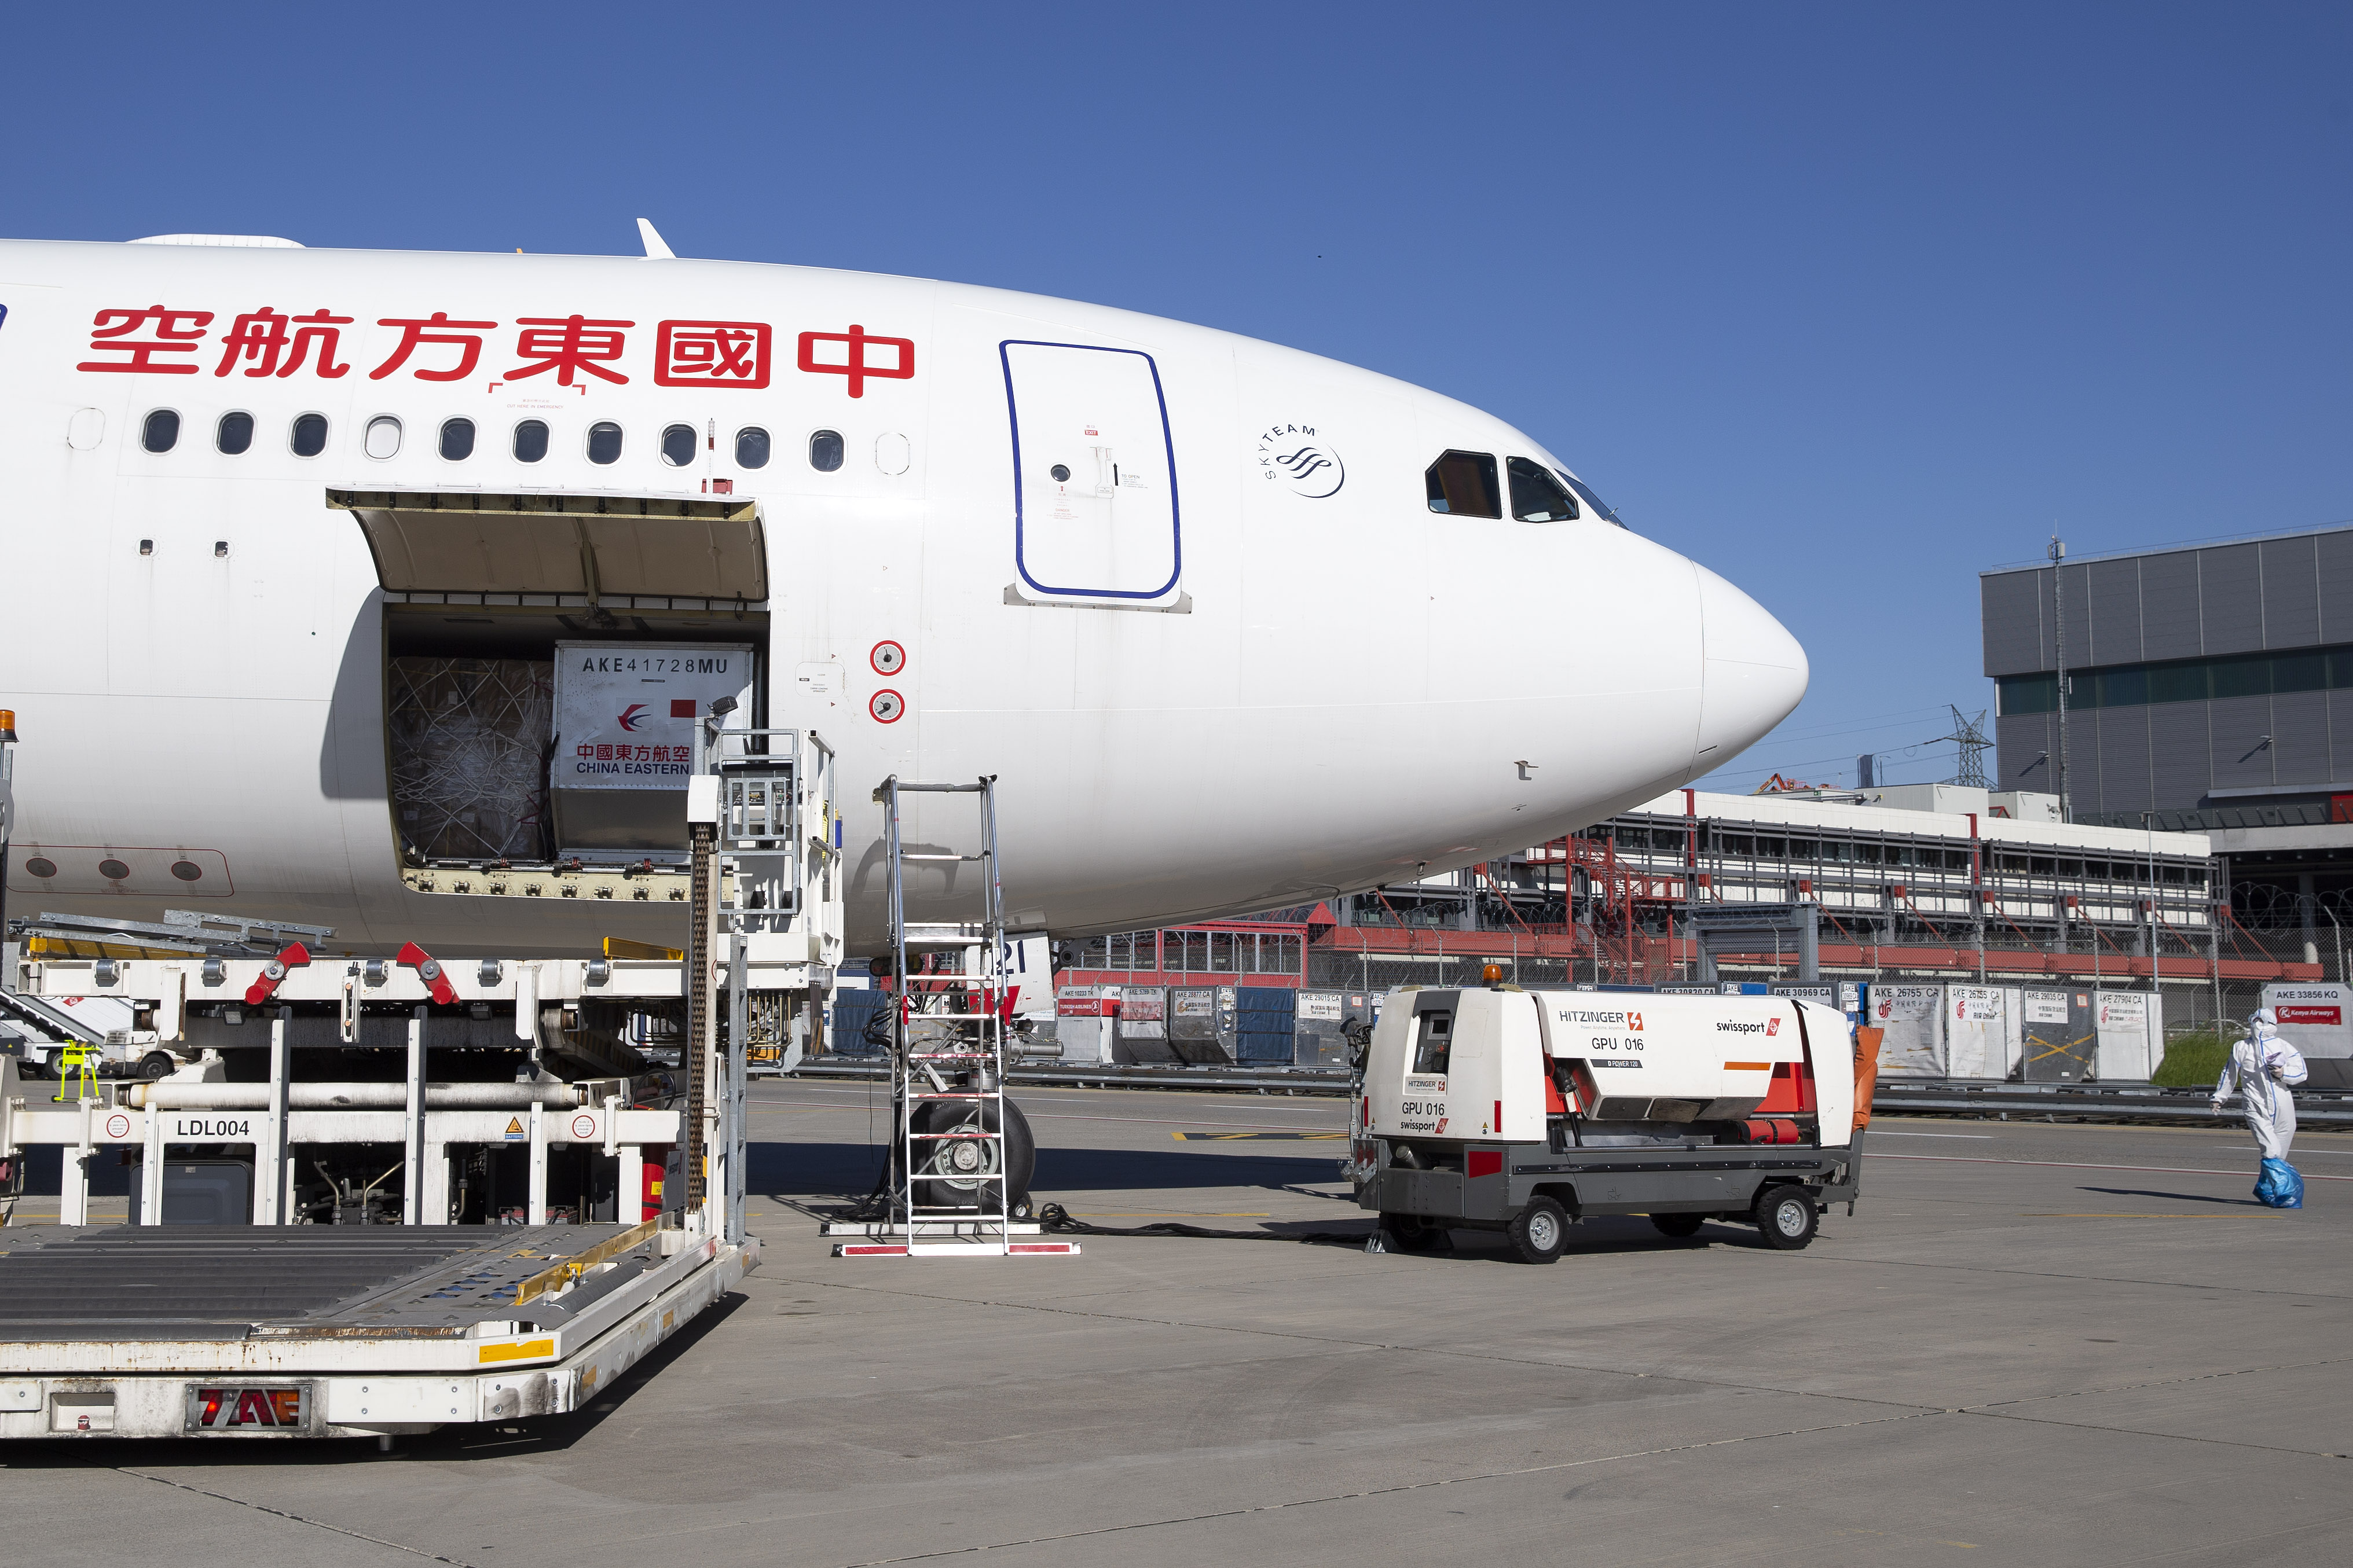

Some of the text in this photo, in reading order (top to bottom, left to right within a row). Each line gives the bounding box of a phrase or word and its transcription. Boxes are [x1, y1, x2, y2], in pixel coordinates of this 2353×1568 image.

[1258, 424, 1315, 480] SKYTEAM
[577, 743, 690, 762] 中國東方航空
[576, 762, 690, 775] CHINA EASTERN
[1874, 988, 1893, 997] AKE
[1897, 988, 1922, 997] 26755
[1952, 988, 2000, 1000] AKE 26755 CA
[2027, 992, 2039, 1000] AKE
[2041, 992, 2056, 1000] 29035
[2099, 994, 2142, 1004] AKE 27904 CA
[2277, 990, 2339, 999] AKE 33856 KQ
[1559, 1011, 1625, 1023] HITZINGER
[1716, 1019, 1765, 1035] swissport
[1592, 1037, 1644, 1051] GPU 016
[1402, 1101, 1445, 1116] GPU 016
[177, 1120, 250, 1136] LDL004
[1400, 1118, 1435, 1133] swissport
